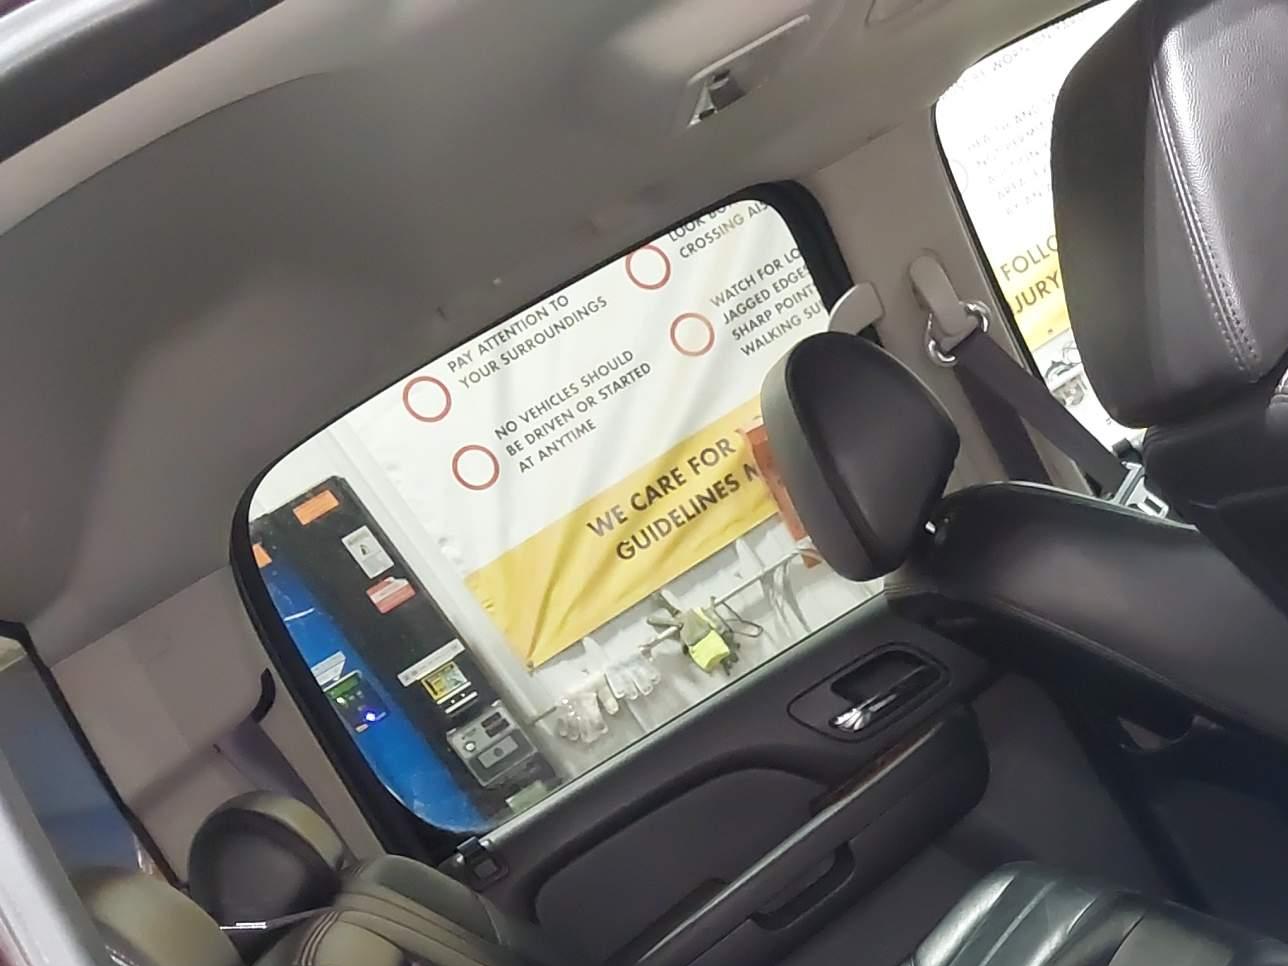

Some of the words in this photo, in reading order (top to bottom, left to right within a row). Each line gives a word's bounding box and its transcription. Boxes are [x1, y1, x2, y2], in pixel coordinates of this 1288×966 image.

[679, 213, 745, 258] CROSSING
[709, 274, 757, 308] WATCH
[756, 258, 784, 281] FOR
[723, 288, 771, 325] JAGGED
[447, 350, 473, 373] PAY
[477, 307, 550, 355] ATTENTION
[549, 295, 569, 311] TO
[458, 360, 501, 390] YOUR
[500, 296, 608, 366] SURROUNDINGS
[731, 309, 773, 341] SHARP
[740, 316, 801, 357] WALKING
[803, 299, 824, 319] SU
[494, 420, 518, 440] NO
[518, 383, 580, 425] VEHICLES
[580, 350, 634, 388] SHOULD
[505, 440, 524, 457] BE
[524, 408, 575, 445] DRIVEN
[576, 395, 598, 413] OR
[598, 362, 651, 400] STARTED
[518, 455, 535, 473] AT
[537, 418, 597, 462] ANYTIME
[586, 504, 629, 537] WE
[630, 467, 687, 511] CARE
[687, 438, 737, 476] FOR
[616, 473, 741, 560] GUIDELINES
